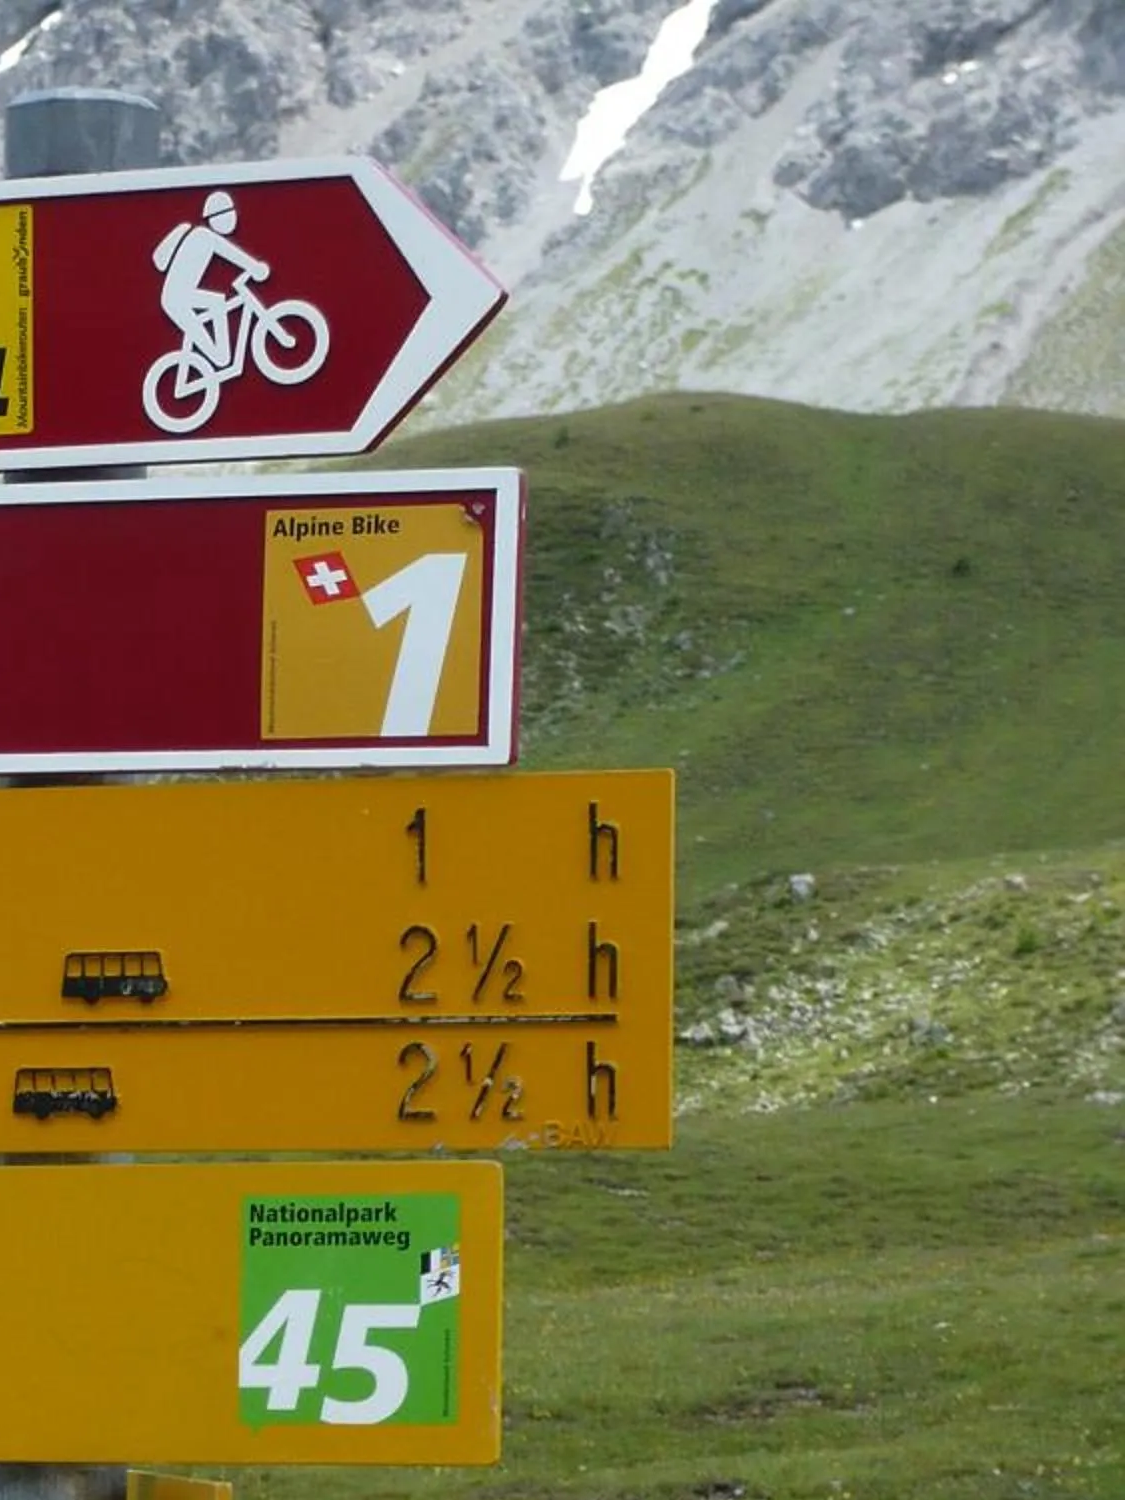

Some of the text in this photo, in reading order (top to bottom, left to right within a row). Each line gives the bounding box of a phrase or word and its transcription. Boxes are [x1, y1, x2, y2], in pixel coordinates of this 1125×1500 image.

[273, 515, 400, 541] Alpine Bike
[360, 552, 468, 737] 1
[405, 807, 427, 885] 1
[588, 801, 620, 881] h
[587, 921, 620, 1001] h
[586, 1041, 619, 1121] h
[249, 1203, 398, 1228] Nationalpark
[249, 1228, 411, 1251] Panoramaweg
[239, 1289, 422, 1425] 45
